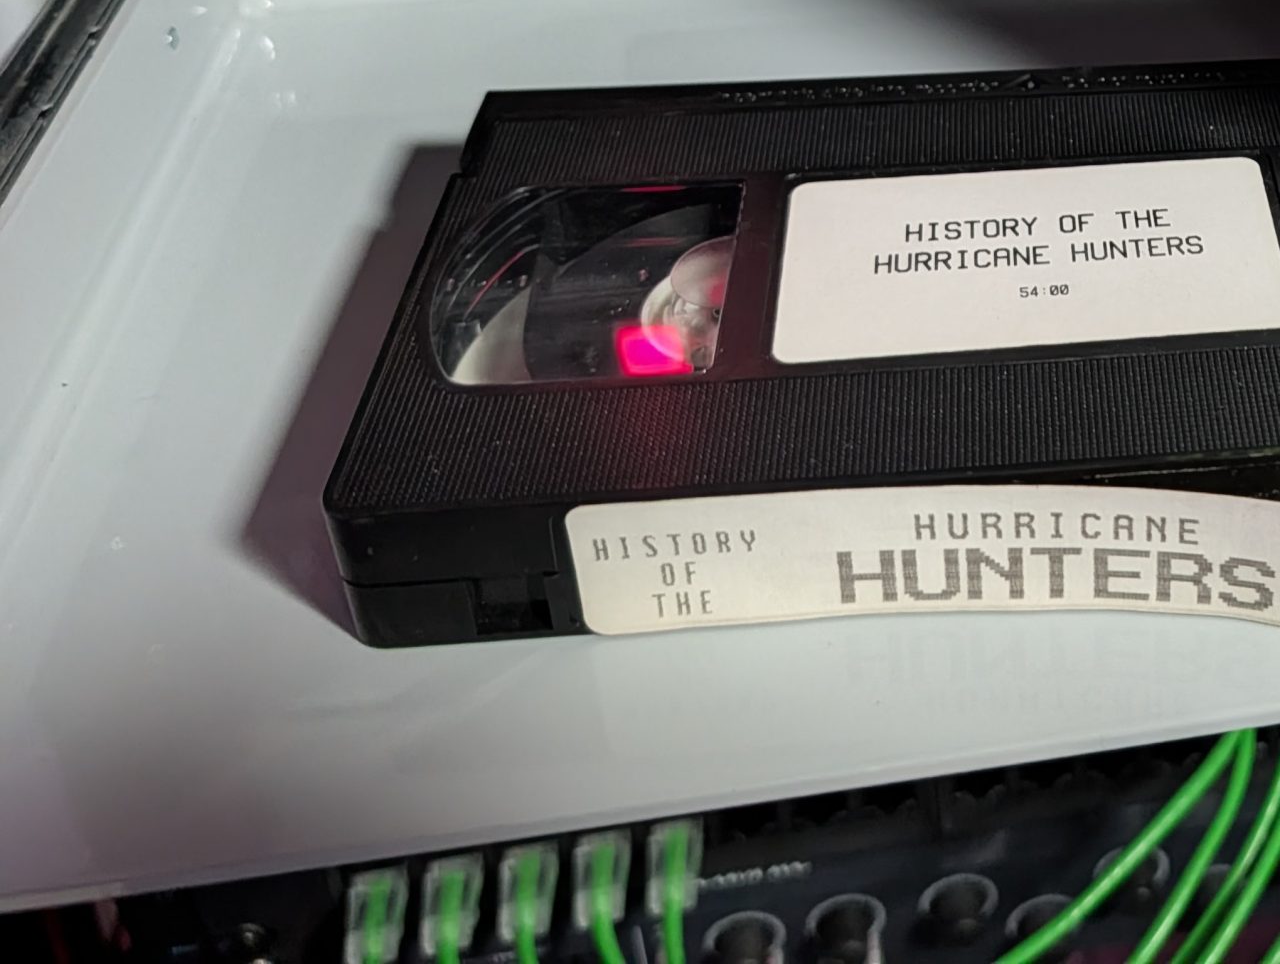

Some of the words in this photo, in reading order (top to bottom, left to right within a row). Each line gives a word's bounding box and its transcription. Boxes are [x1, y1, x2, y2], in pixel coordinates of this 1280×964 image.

[904, 217, 1038, 244] HISTORY
[1059, 213, 1095, 235] OF
[1115, 208, 1172, 230] THE
[873, 244, 1051, 275] HURRICANE
[1071, 235, 1205, 263] HUNTERS
[1018, 283, 1070, 299] 54:00
[914, 510, 1200, 545] HURRICANE
[592, 529, 758, 562] HISTORY
[660, 561, 698, 587] OF
[836, 547, 1277, 612] HUNTERS
[652, 589, 714, 619] THE
